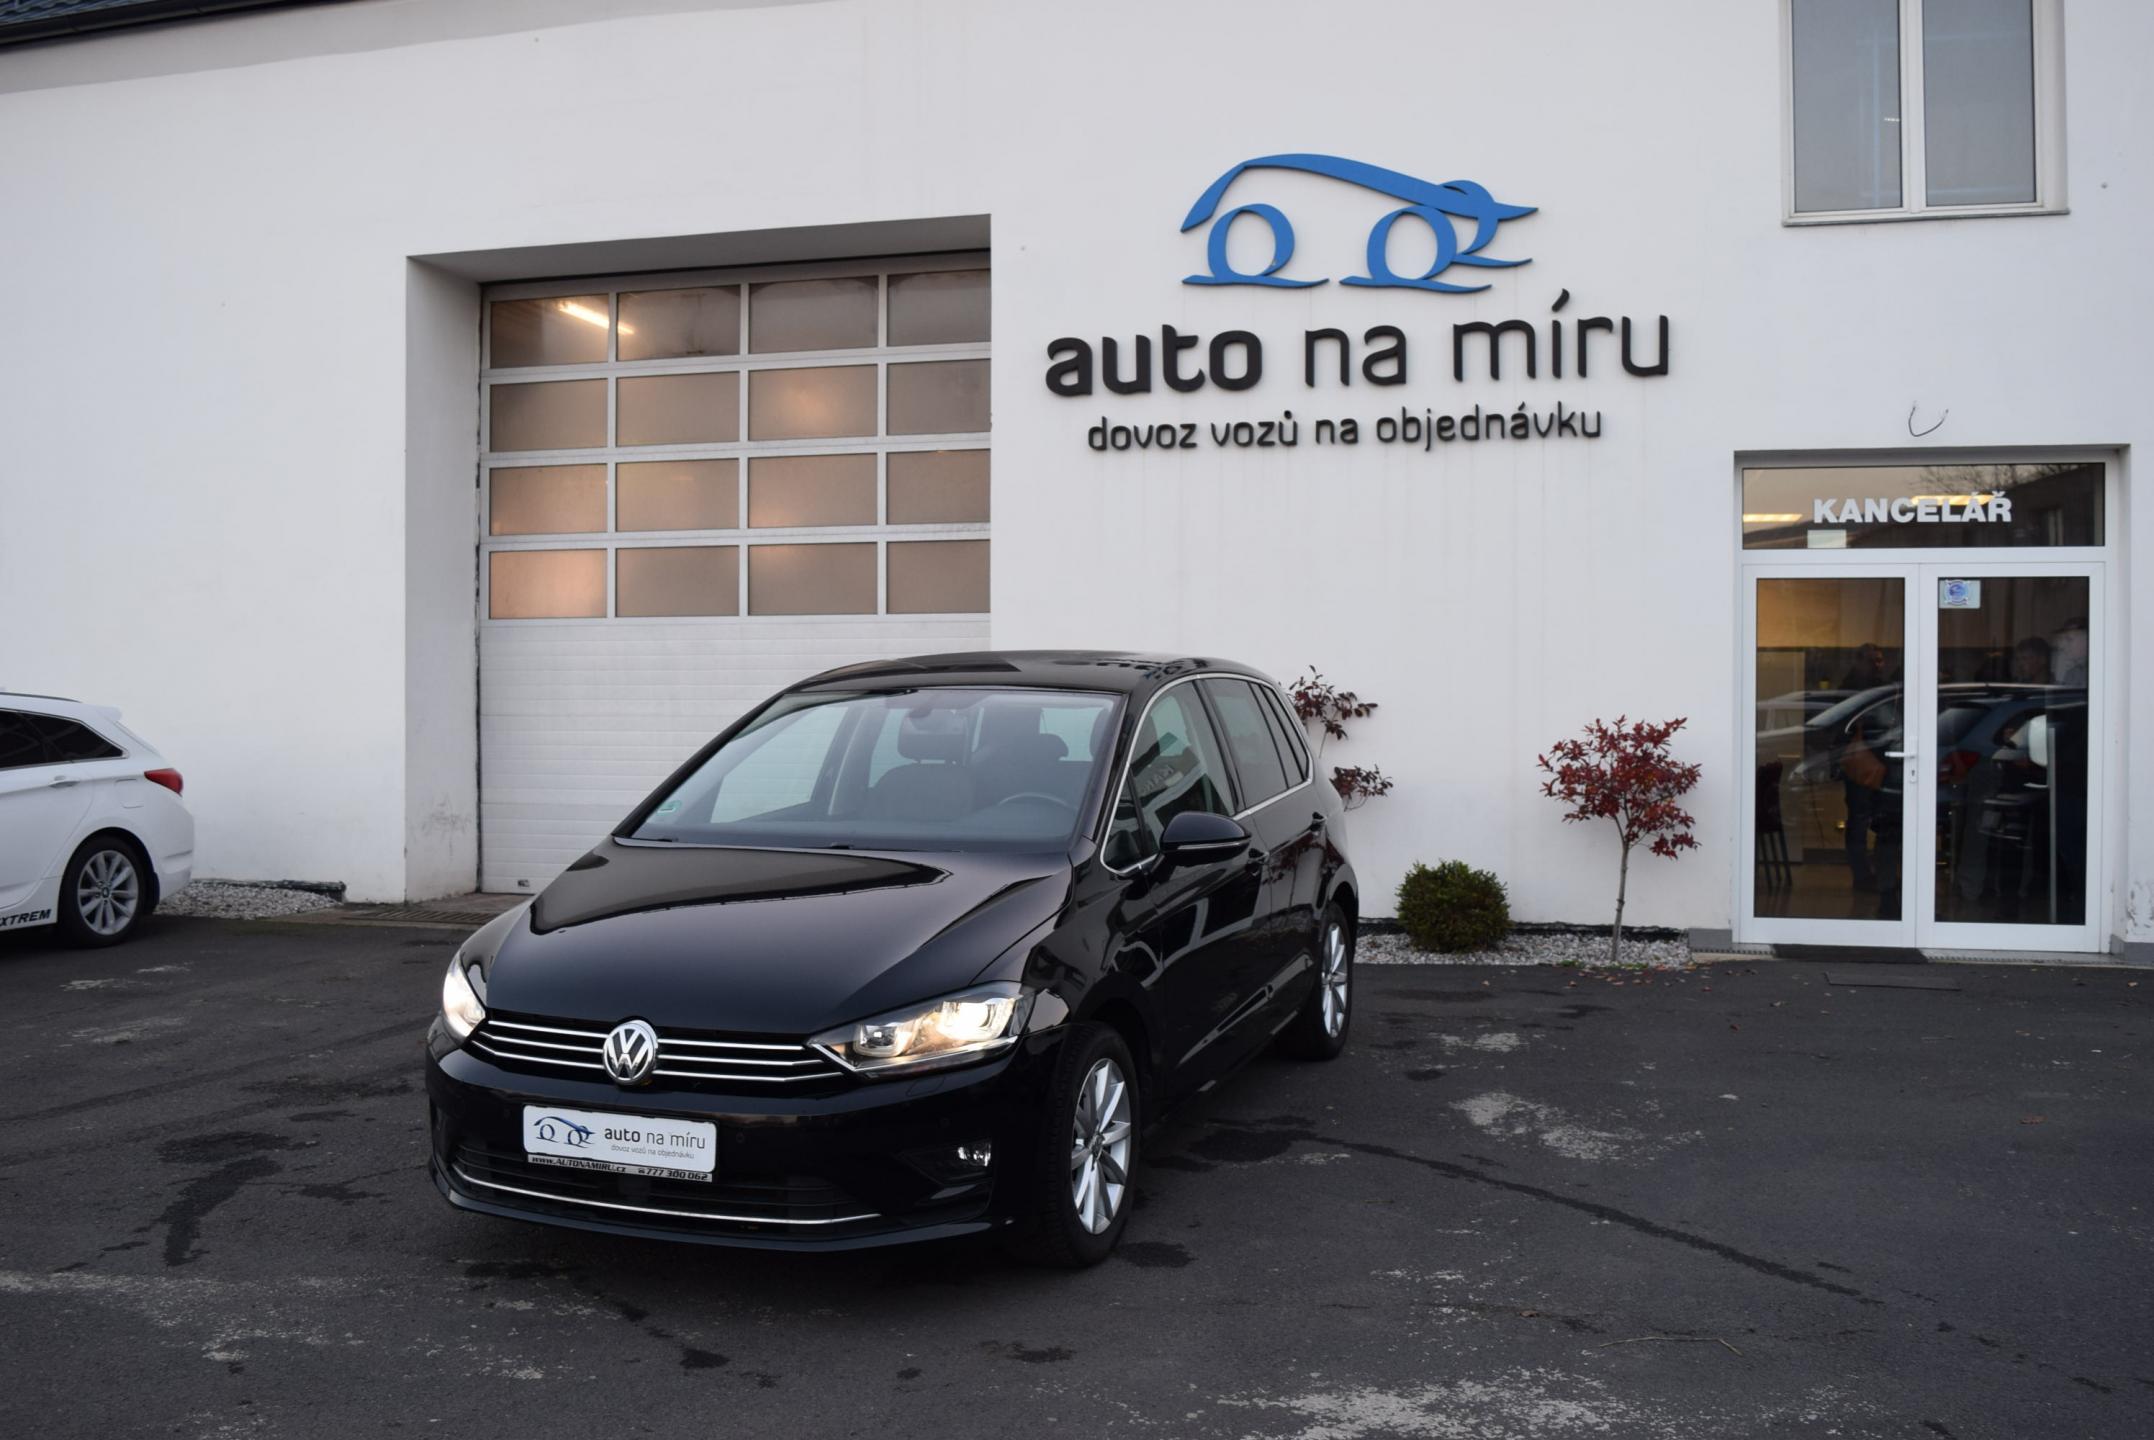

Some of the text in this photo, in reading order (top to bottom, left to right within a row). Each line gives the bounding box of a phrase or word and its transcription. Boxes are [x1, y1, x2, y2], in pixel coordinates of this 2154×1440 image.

[1046, 288, 1669, 397] auto na míru
[1088, 401, 1601, 452] dovoz vozů na objednávku
[1813, 491, 2012, 523] KANCELÁŘ
[0, 909, 52, 927] XTREM
[604, 1128, 705, 1149] auto na míru
[646, 1167, 663, 1177] 777
